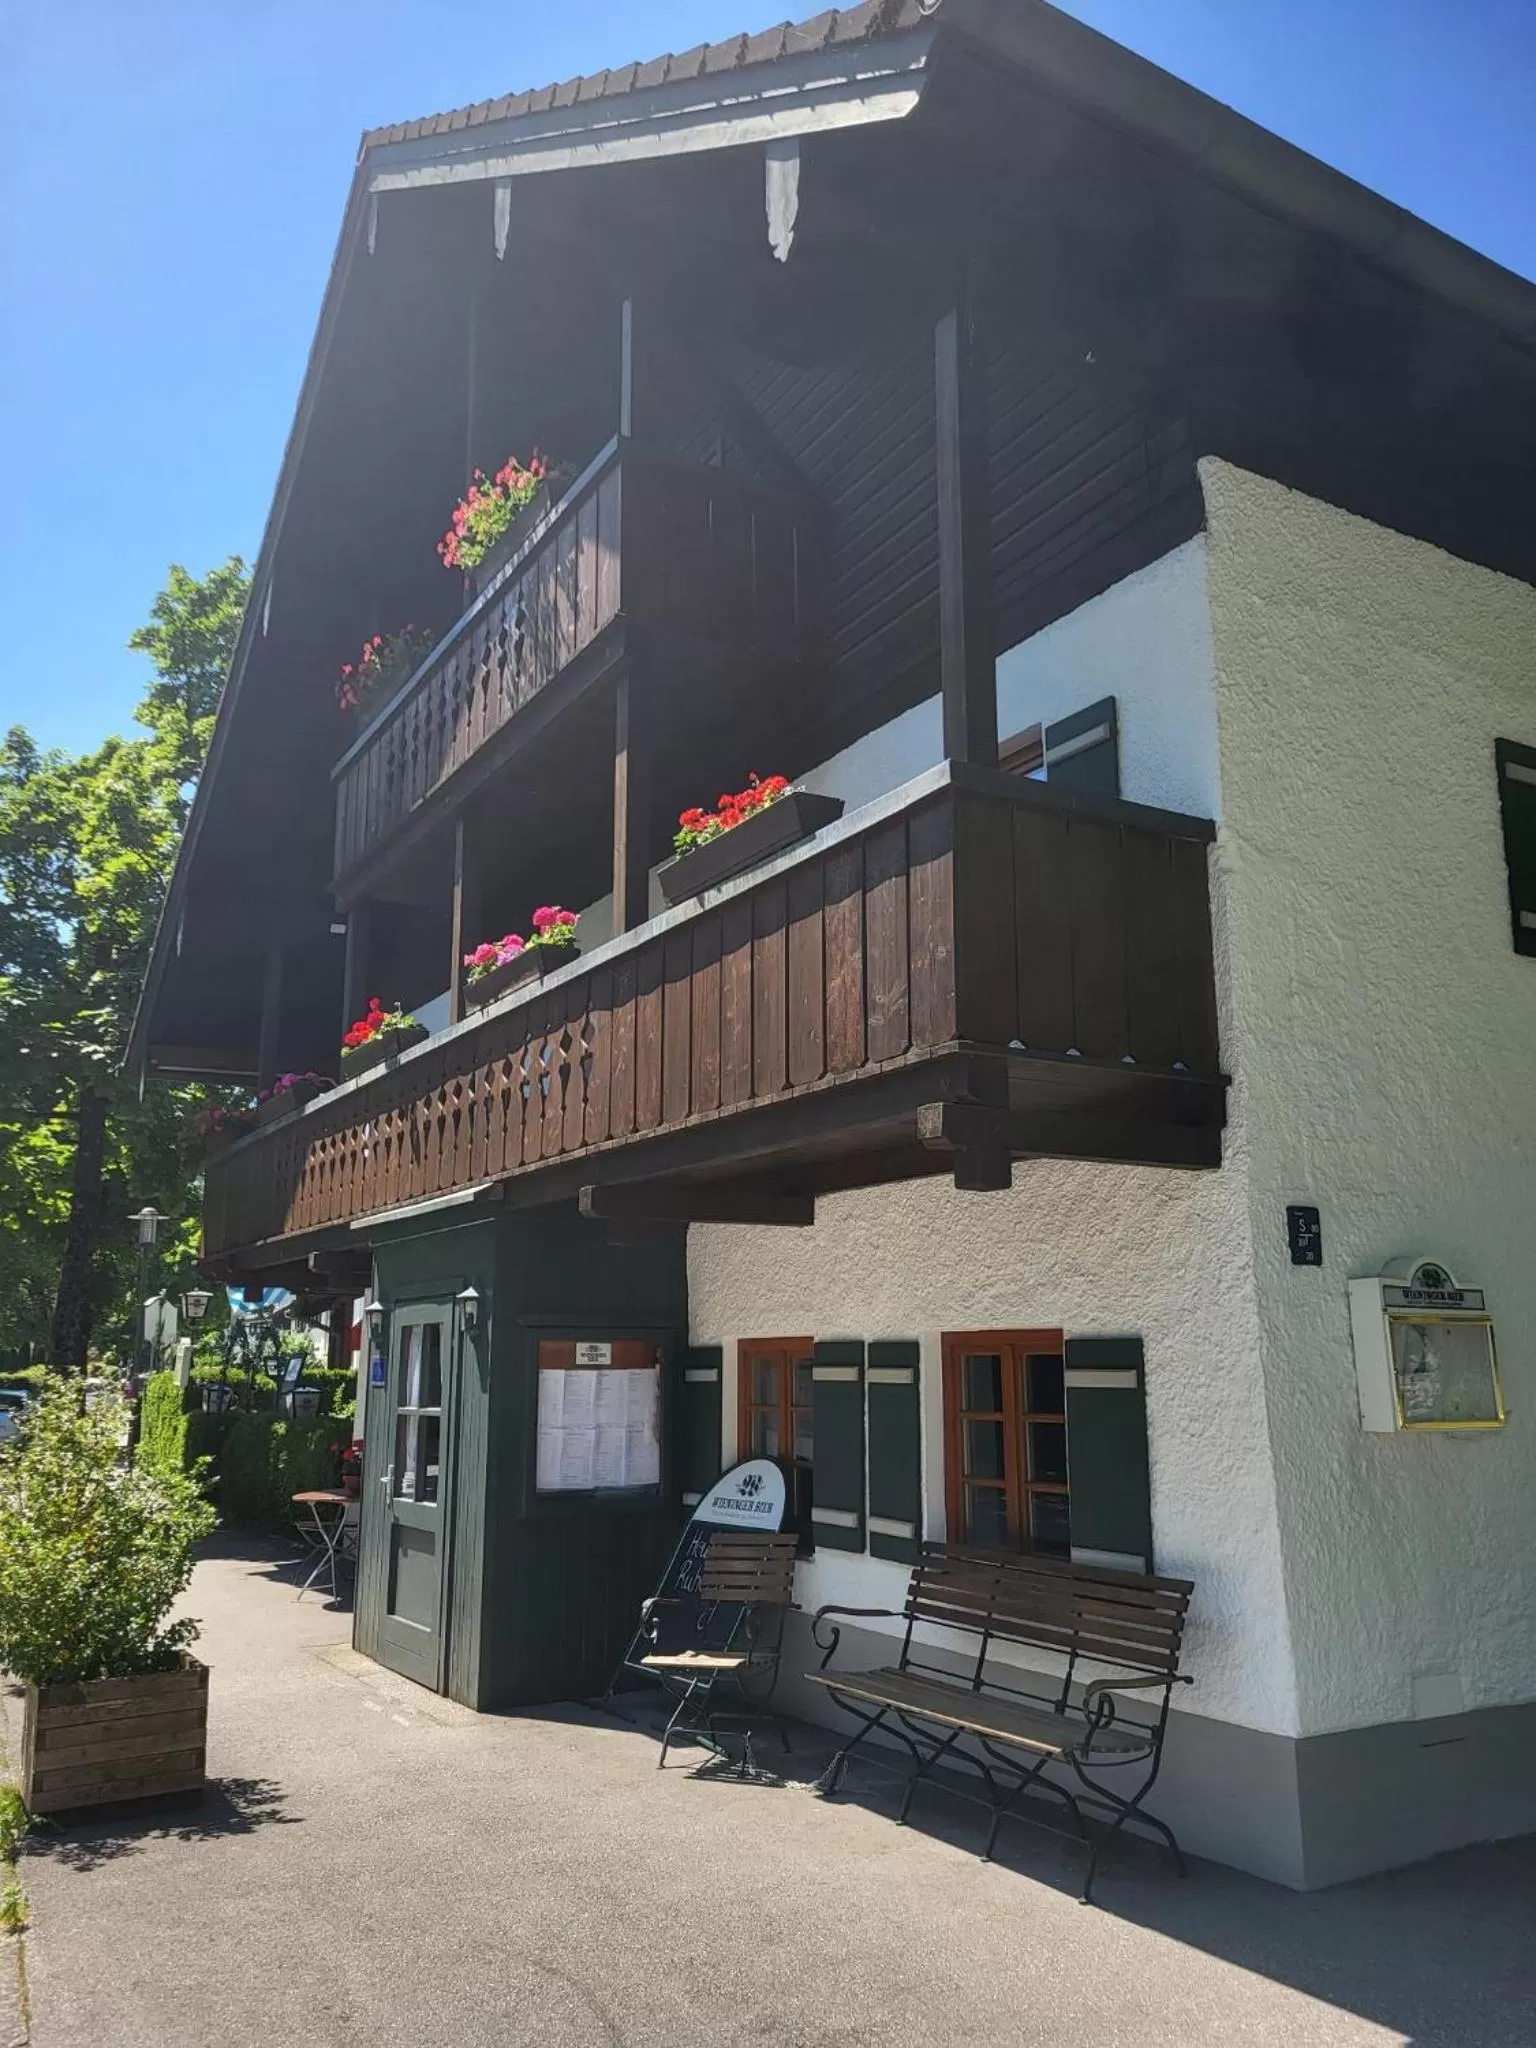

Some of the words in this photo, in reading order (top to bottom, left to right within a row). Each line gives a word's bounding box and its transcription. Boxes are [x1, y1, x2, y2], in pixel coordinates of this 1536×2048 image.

[712, 1497, 755, 1512] WIENINGER
[753, 1500, 774, 1513] BIER
[686, 1528, 710, 1558] Heu
[674, 1560, 702, 1592] Ruh
